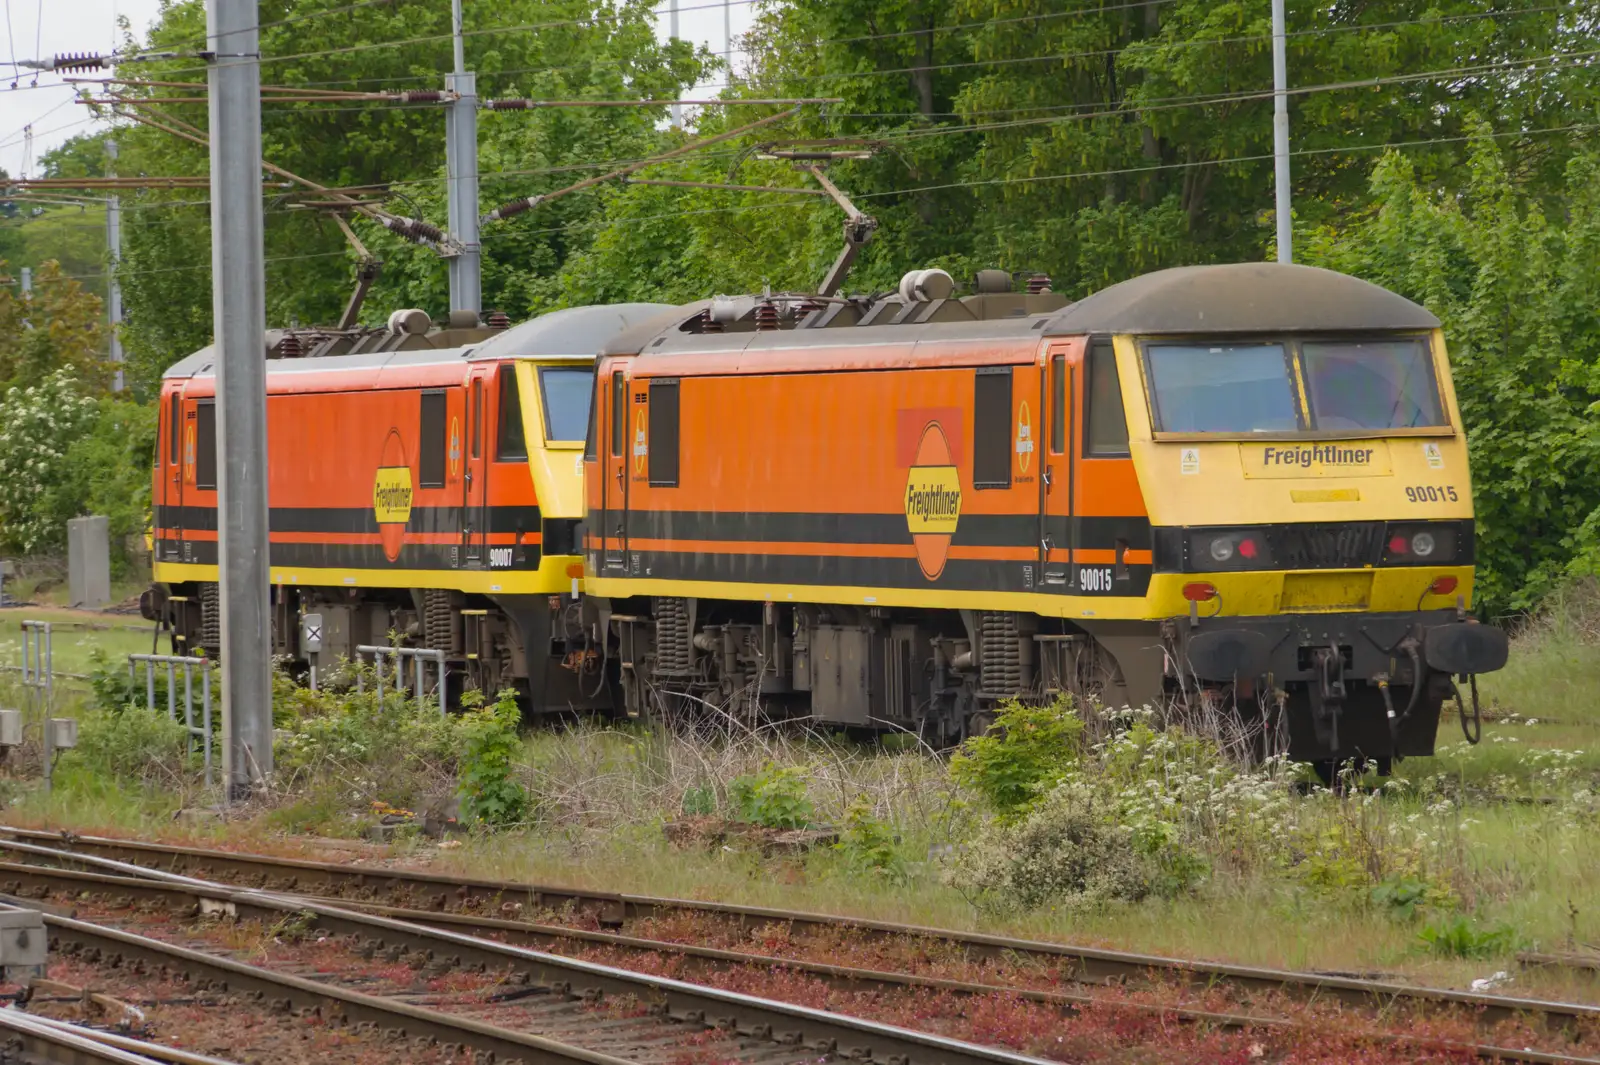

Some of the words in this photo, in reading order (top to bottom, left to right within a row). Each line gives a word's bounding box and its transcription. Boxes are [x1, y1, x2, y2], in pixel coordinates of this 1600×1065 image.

[1264, 445, 1374, 468] Freightliner
[376, 482, 412, 514] Freightliner
[907, 483, 960, 522] Freightliner
[1405, 485, 1459, 502] 90015
[490, 548, 513, 567] 90007
[1080, 568, 1112, 591] 90015
